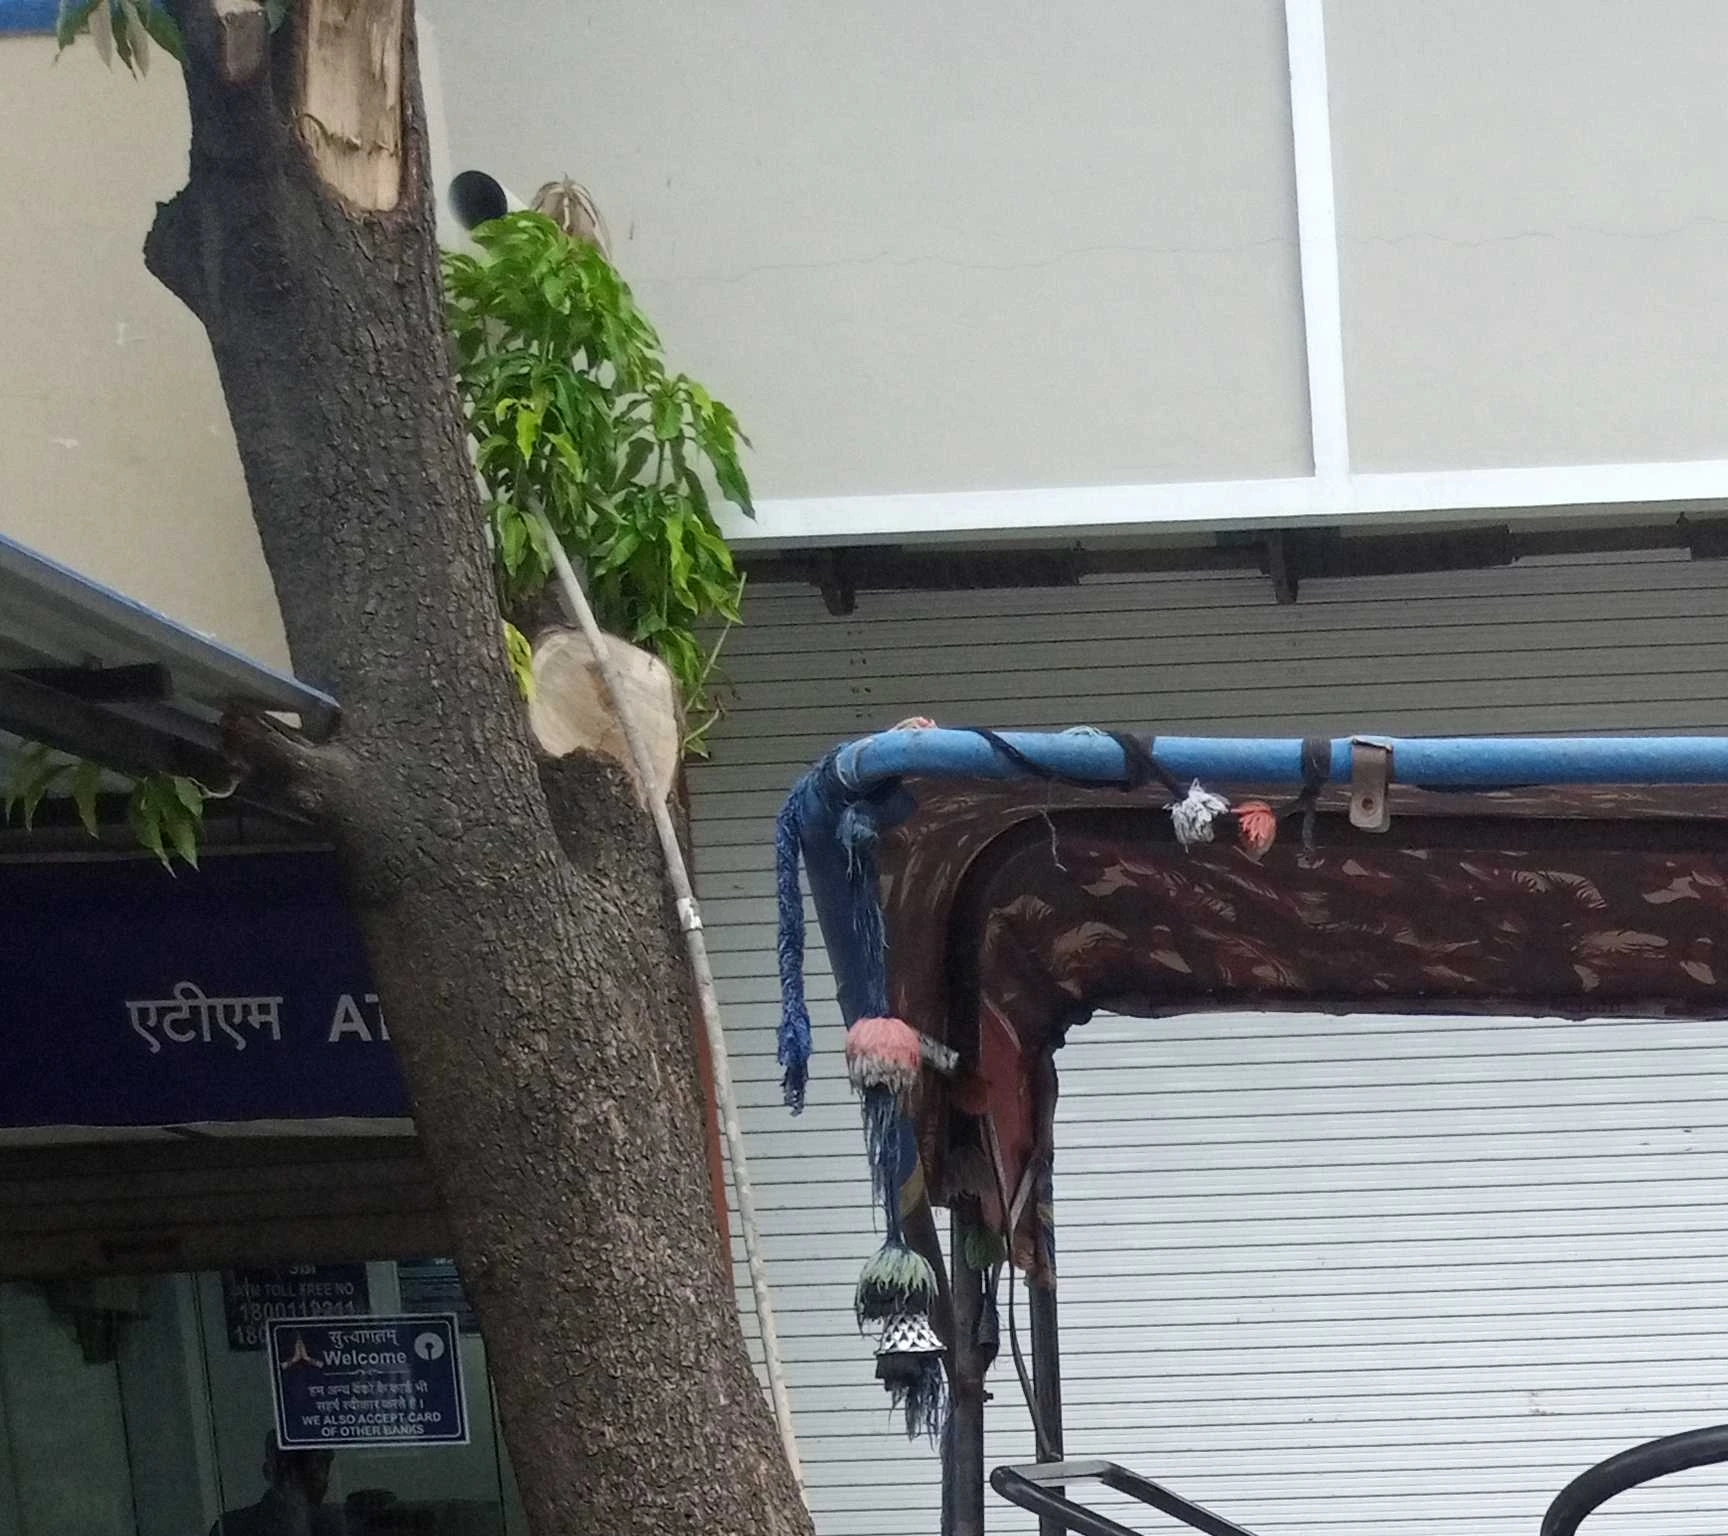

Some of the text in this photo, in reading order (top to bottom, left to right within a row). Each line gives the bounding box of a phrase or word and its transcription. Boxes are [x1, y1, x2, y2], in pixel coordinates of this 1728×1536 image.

[126, 981, 284, 1054] एटीएम
[264, 1283, 296, 1297] TOLL
[323, 1350, 407, 1367] Welcome
[302, 1411, 441, 1426] WE ALSO ACCEPT CARD
[321, 1424, 424, 1437] OF OTHER BANKS
